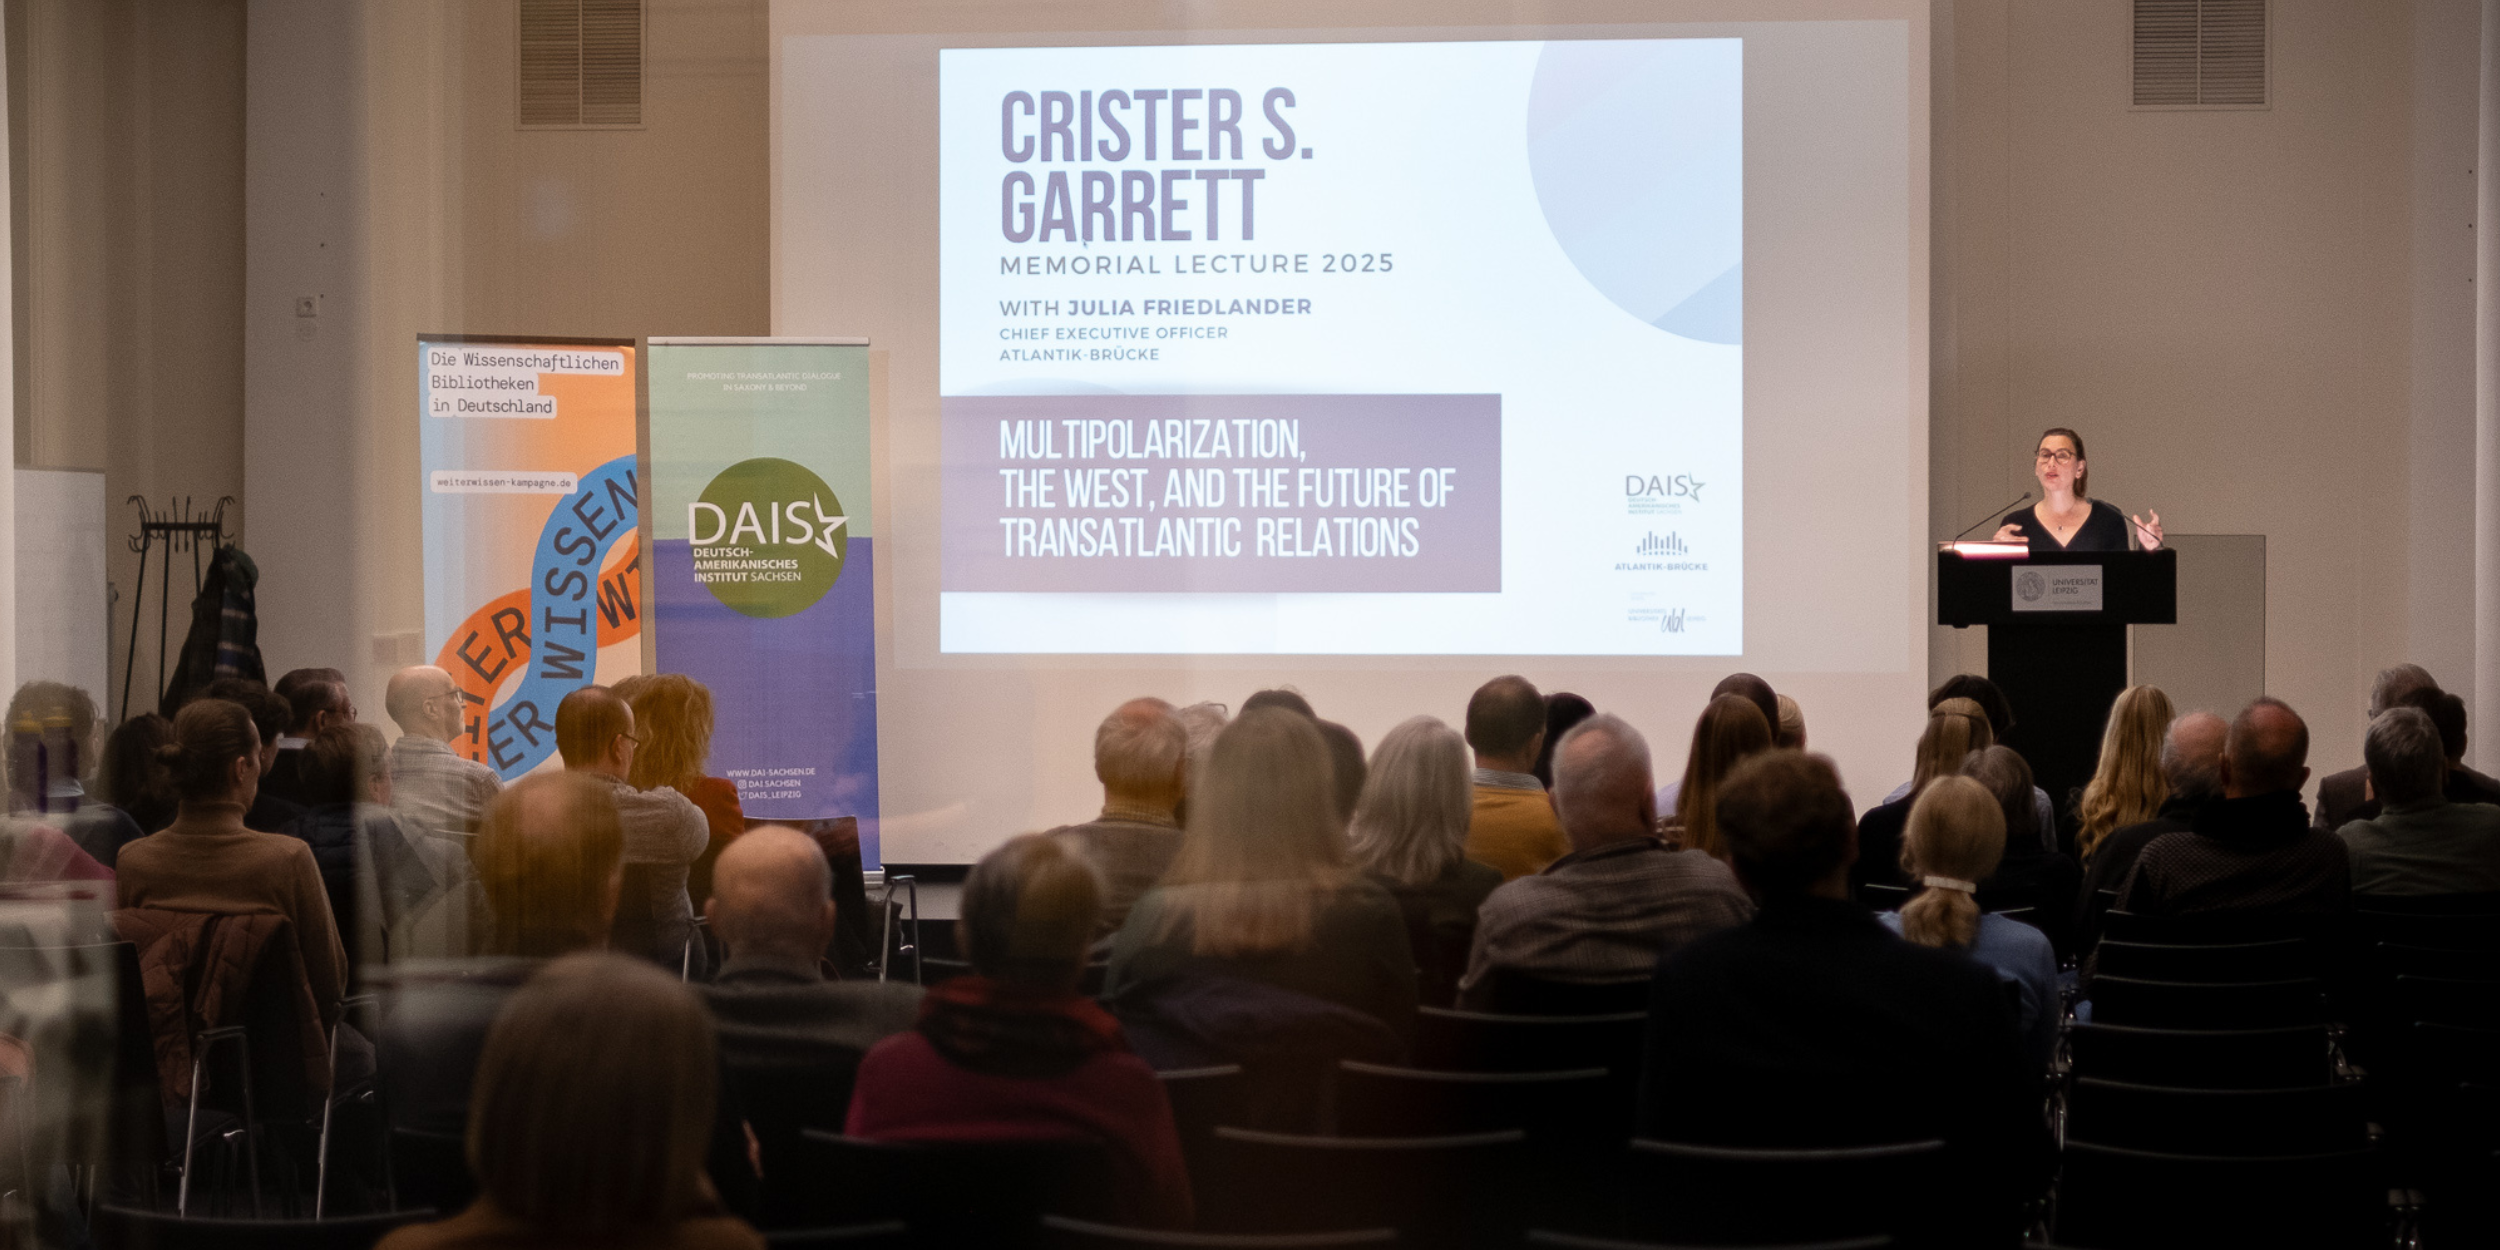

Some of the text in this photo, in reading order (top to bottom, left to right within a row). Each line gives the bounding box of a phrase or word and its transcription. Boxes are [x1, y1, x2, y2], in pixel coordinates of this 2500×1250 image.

[1001, 87, 1313, 163] CRISTER S.
[1001, 169, 1265, 243] GARRETT
[1000, 253, 1393, 275] MEMORIAL LECTURE 2025
[1000, 299, 1312, 316] WITH JULIA FRIEDLANDER
[1000, 327, 1228, 340] CHIEF EXECUTIVE OFFICER
[1000, 345, 1160, 361] ATLANTIK-BRÜCKE
[431, 352, 620, 372] Die Wissenschaftlichen
[432, 375, 534, 390] Bibliotheken
[687, 372, 841, 380] PROMOTING TRANSATLANTIC DIALOGUE
[433, 399, 552, 413] in Deutschland
[1000, 419, 1306, 461] MULTIPOLARIZATION,
[437, 477, 571, 489] weiterwissen-kampagne.de
[1000, 467, 1456, 511] THE WEST, AND THE FUTURE OF
[1625, 475, 1689, 497] DAIS
[688, 501, 814, 545] DAIS
[1000, 516, 1420, 558] TRANSATLANTIC RELATIONS
[693, 547, 753, 558] DEUTSCH-
[693, 559, 798, 570] AMERIKANISCHES
[1615, 562, 1708, 571] ATLANTIK-BRÜCKE
[694, 571, 801, 582] INSTITUT SACHSEN
